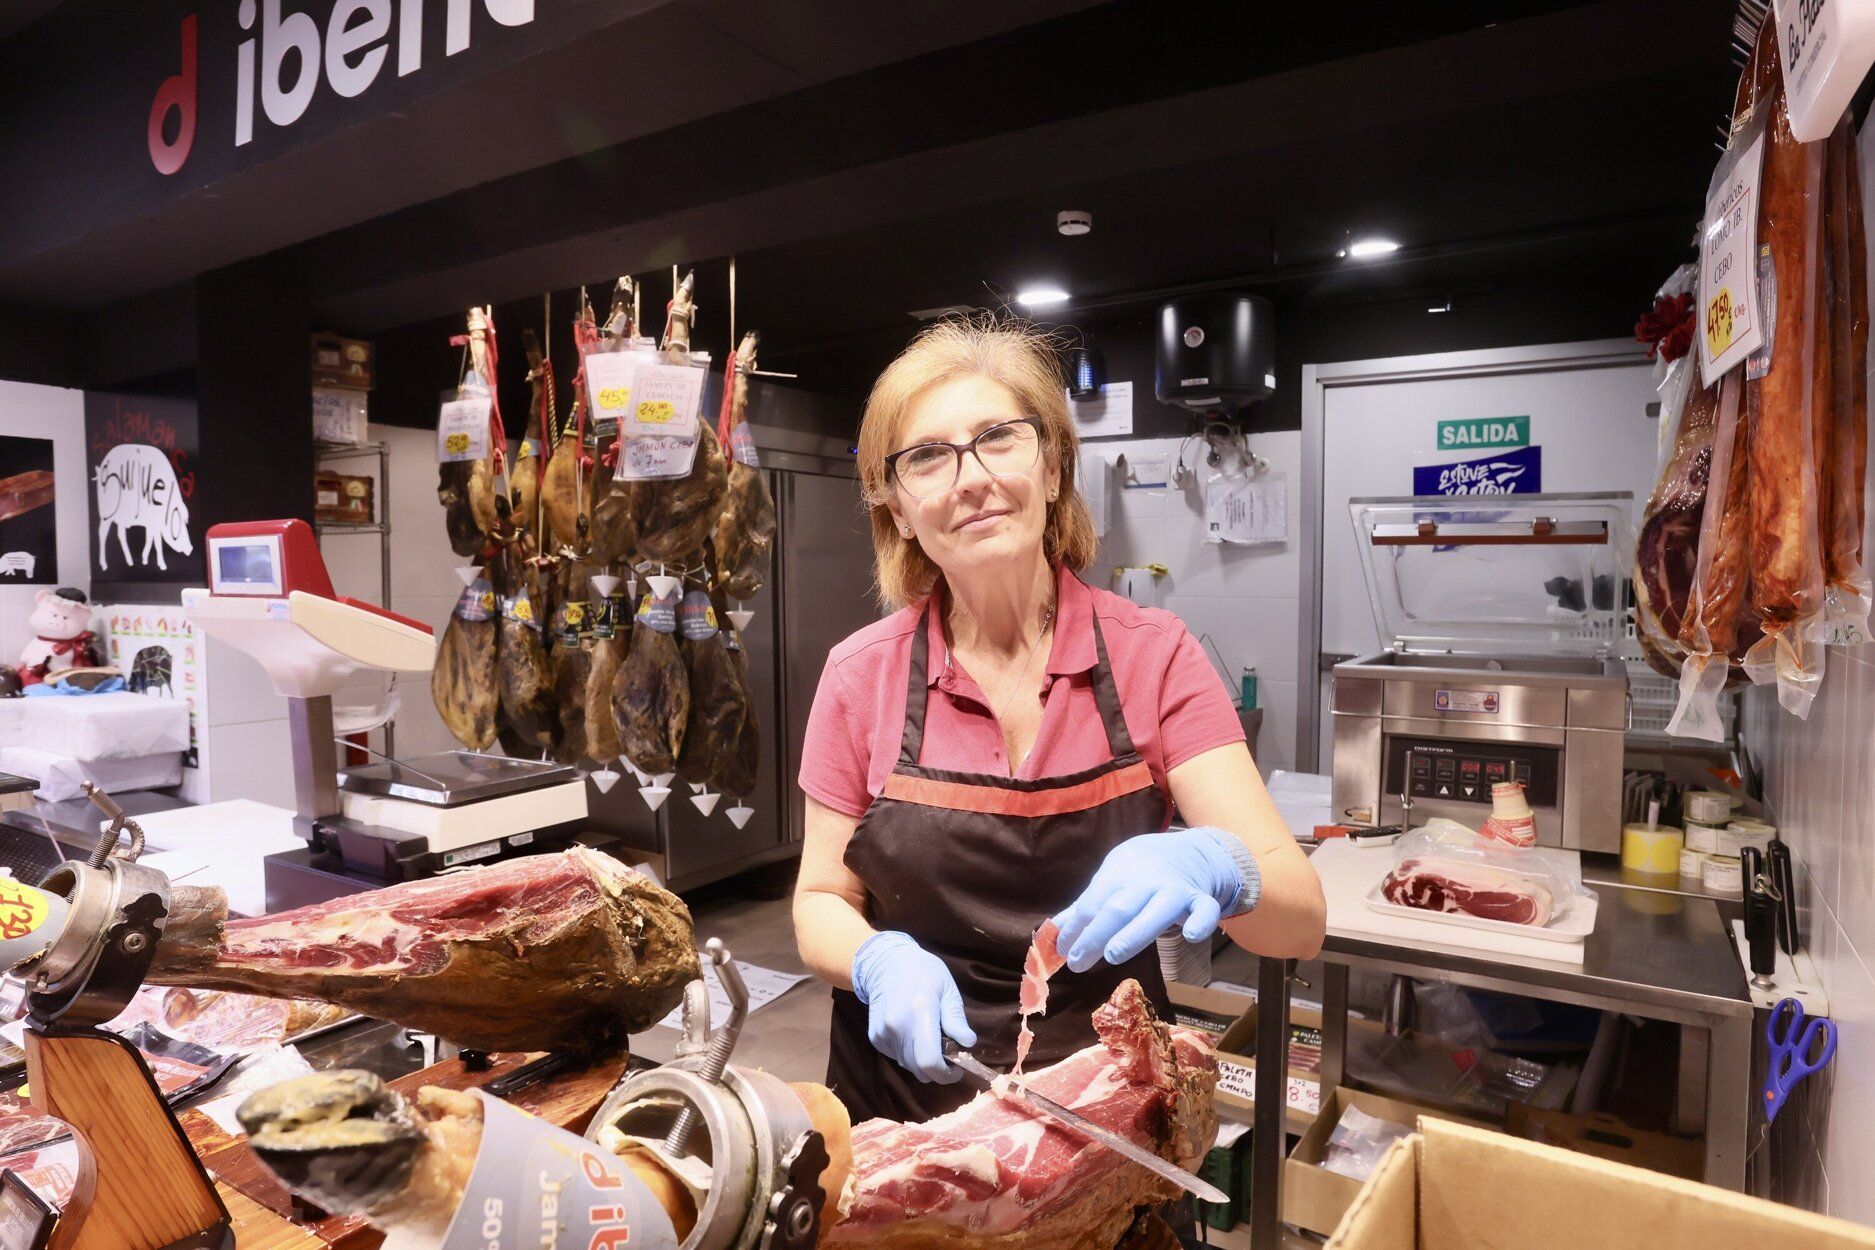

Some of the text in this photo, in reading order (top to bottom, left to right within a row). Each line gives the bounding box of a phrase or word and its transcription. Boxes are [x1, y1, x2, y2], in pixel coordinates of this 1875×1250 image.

[147, 12, 198, 176] d
[1711, 219, 1731, 255] LOMO
[1714, 252, 1732, 284] CEBO
[1442, 423, 1519, 445] SALIDA
